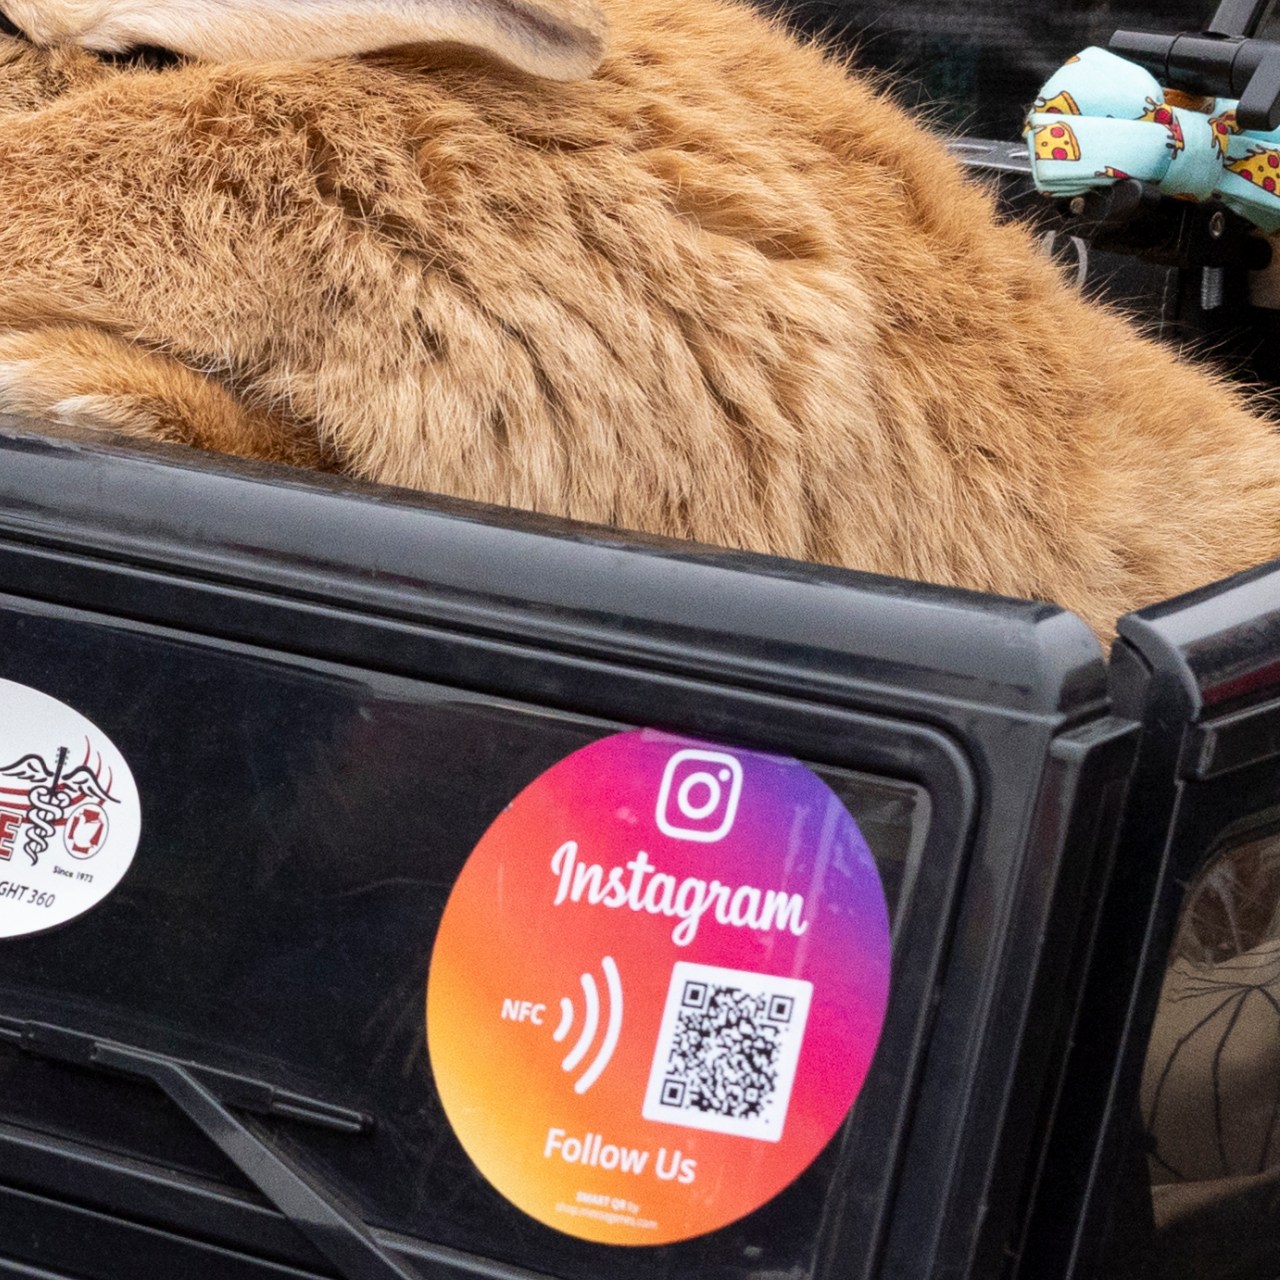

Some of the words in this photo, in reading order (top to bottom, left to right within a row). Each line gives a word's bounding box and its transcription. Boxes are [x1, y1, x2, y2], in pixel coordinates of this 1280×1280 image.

[27, 889, 57, 908] 360
[551, 840, 808, 947] Instagram
[501, 997, 546, 1026] NFC
[543, 1128, 649, 1176] Follow
[655, 1147, 697, 1185] Us
